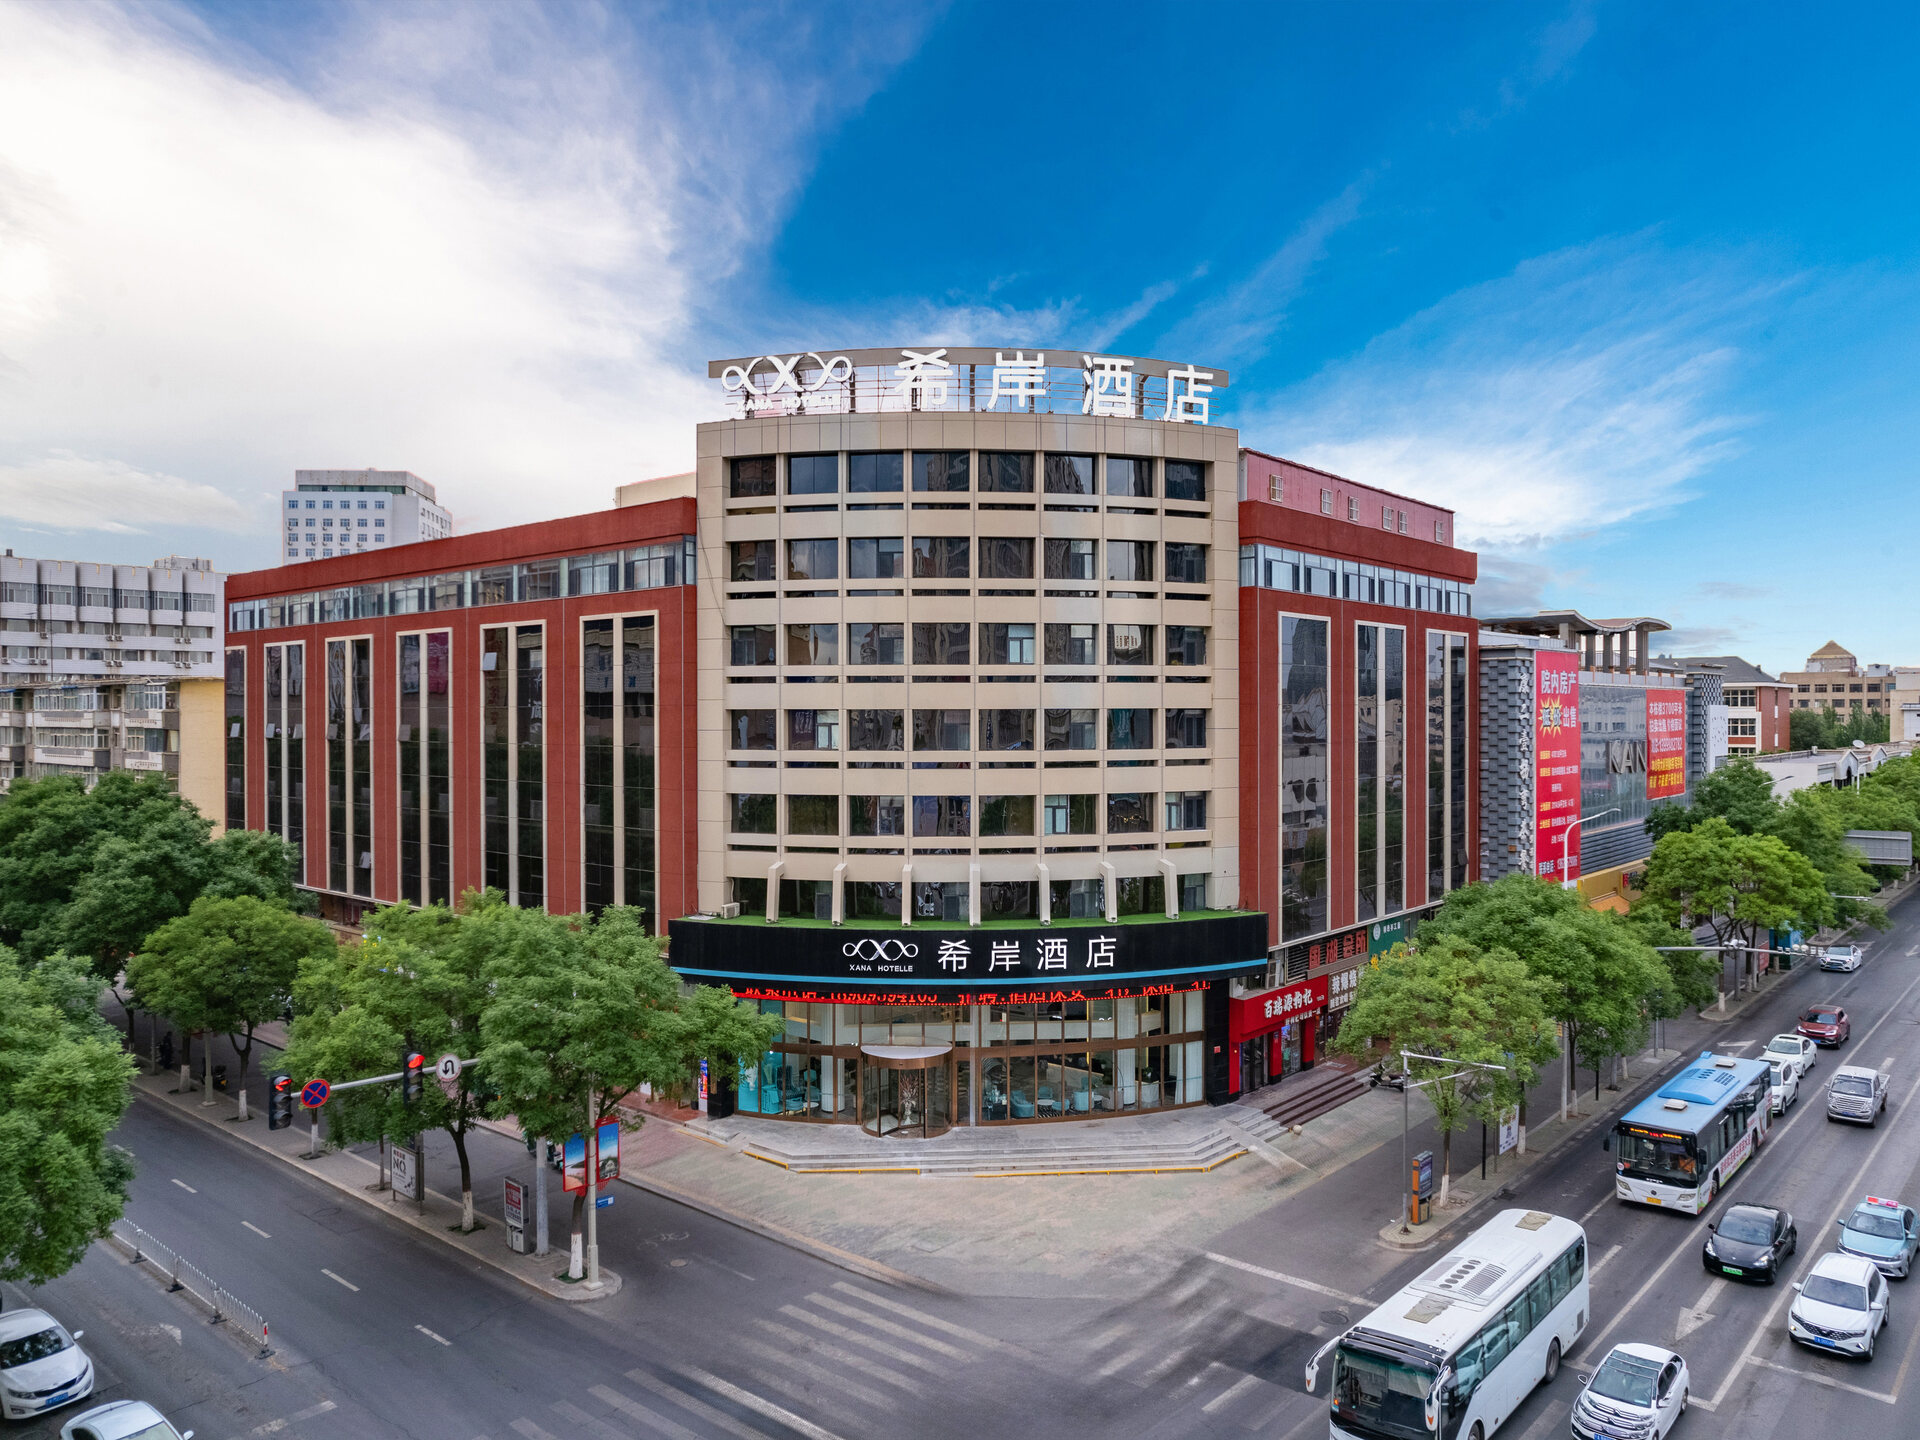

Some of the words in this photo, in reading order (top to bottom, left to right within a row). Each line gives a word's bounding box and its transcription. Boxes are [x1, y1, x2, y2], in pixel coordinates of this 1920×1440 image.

[894, 347, 1214, 425] 希岸酒店
[1541, 669, 1577, 695] 院内房产
[1542, 705, 1577, 728] 低价出售
[937, 935, 1118, 973] 希岸酒店
[849, 964, 873, 972] XANA
[877, 965, 914, 973] HOTELLE
